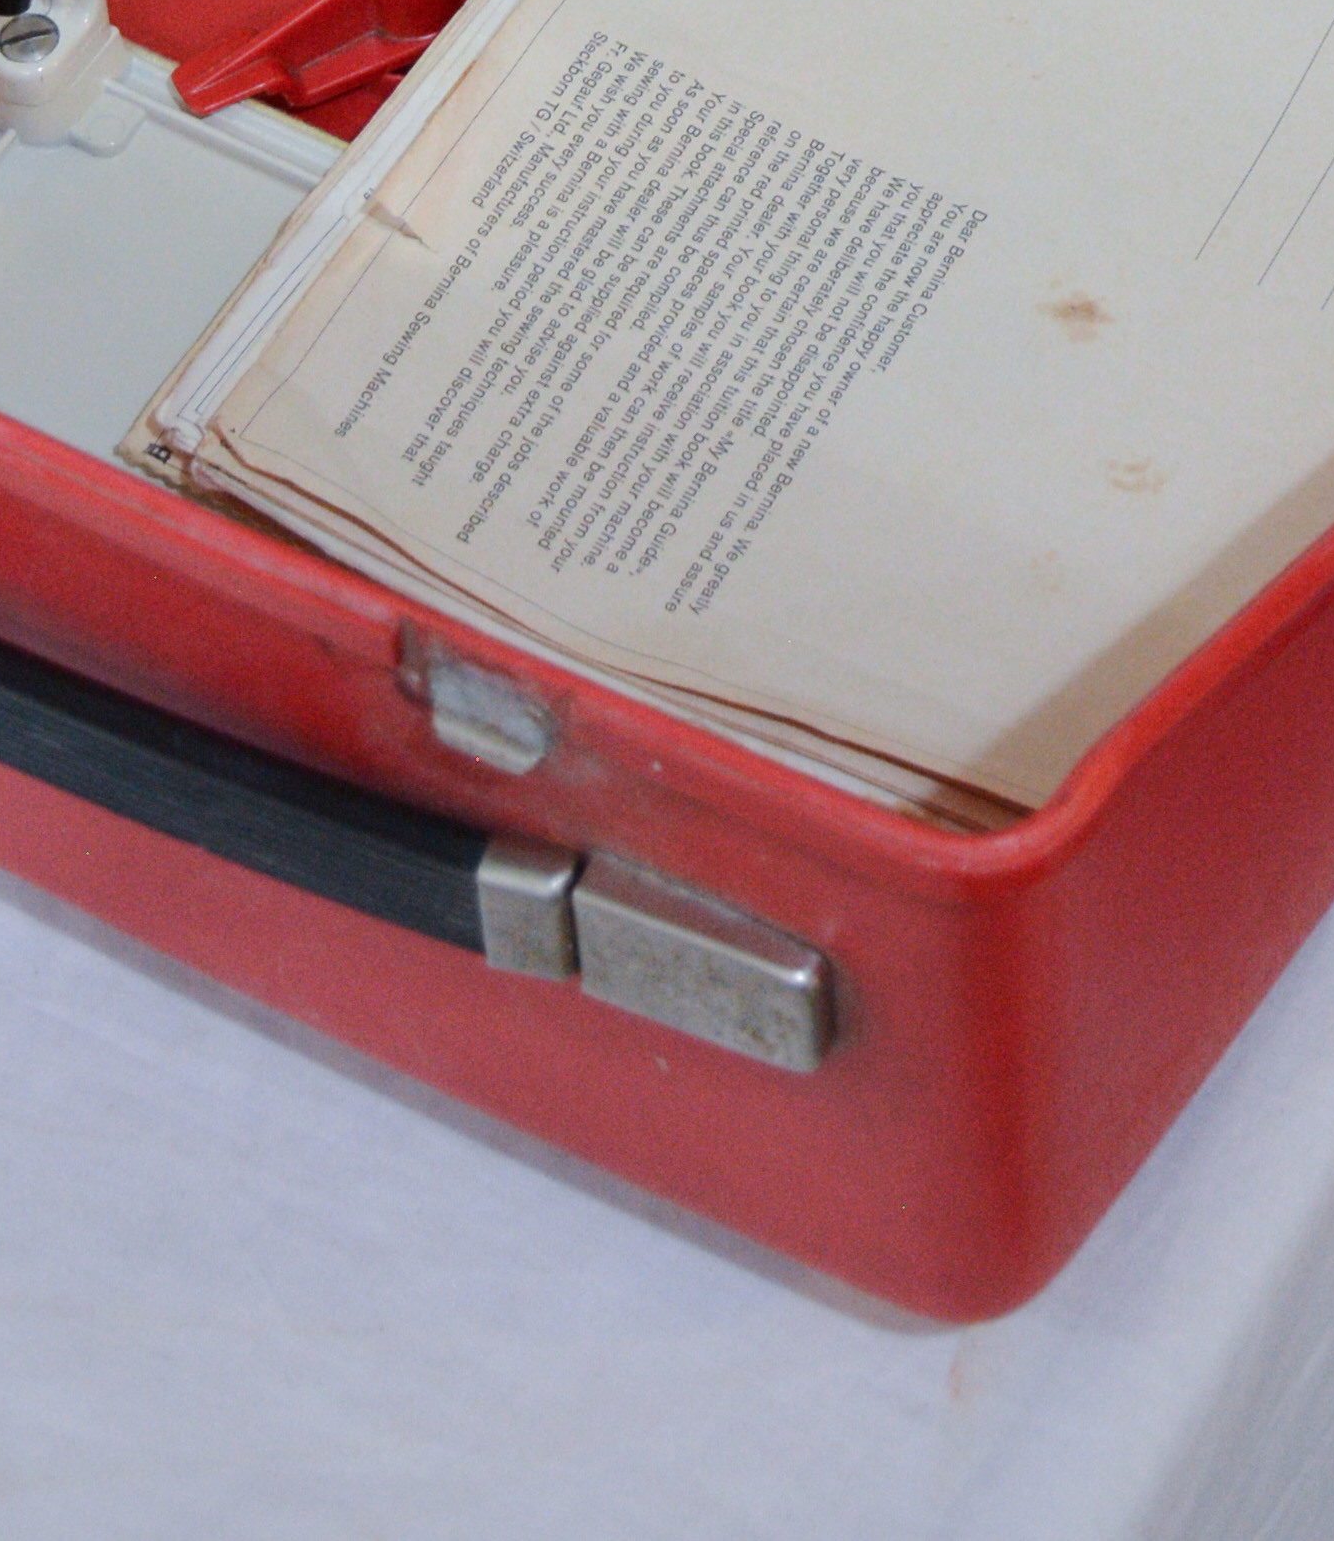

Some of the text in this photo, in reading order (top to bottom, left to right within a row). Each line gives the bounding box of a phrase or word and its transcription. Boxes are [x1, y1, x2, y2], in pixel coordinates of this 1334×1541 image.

[550, 30, 609, 97] Steckborn
[534, 99, 560, 122] TG
[470, 129, 536, 209] Switzerland
[880, 175, 907, 199] We
[333, 39, 629, 438] Fr. Gegauf Ltd., Manufacturers of Bernina Sewing Machines
[857, 199, 890, 234] have
[938, 202, 969, 229] You
[956, 208, 988, 244] Dear
[922, 229, 945, 255] are
[801, 235, 864, 318] deliberately
[902, 255, 929, 289] now
[918, 243, 965, 300] Bernina
[749, 181, 924, 438] you that you will not be disappointed.
[885, 289, 910, 313] the
[454, 109, 765, 544] Special attachments are required for some of the jobs described
[536, 137, 826, 551] Bernina dealer. Your samples of work can then be mounted
[767, 318, 809, 371] chosen
[854, 314, 895, 360] happy
[549, 149, 847, 574] Together with your book you will receive instruction from your
[579, 157, 863, 566] very personal thing to you in association with your machine.
[750, 372, 775, 397] the
[826, 360, 862, 407] owner
[663, 191, 944, 613] appreciate the confidence you have placed in us and assure
[730, 398, 758, 428] title
[814, 407, 831, 427] of
[785, 437, 812, 471] new
[668, 460, 718, 519] Bernina
[742, 471, 793, 532] Bernina.
[724, 537, 752, 562] We
[687, 561, 730, 616] greatly
